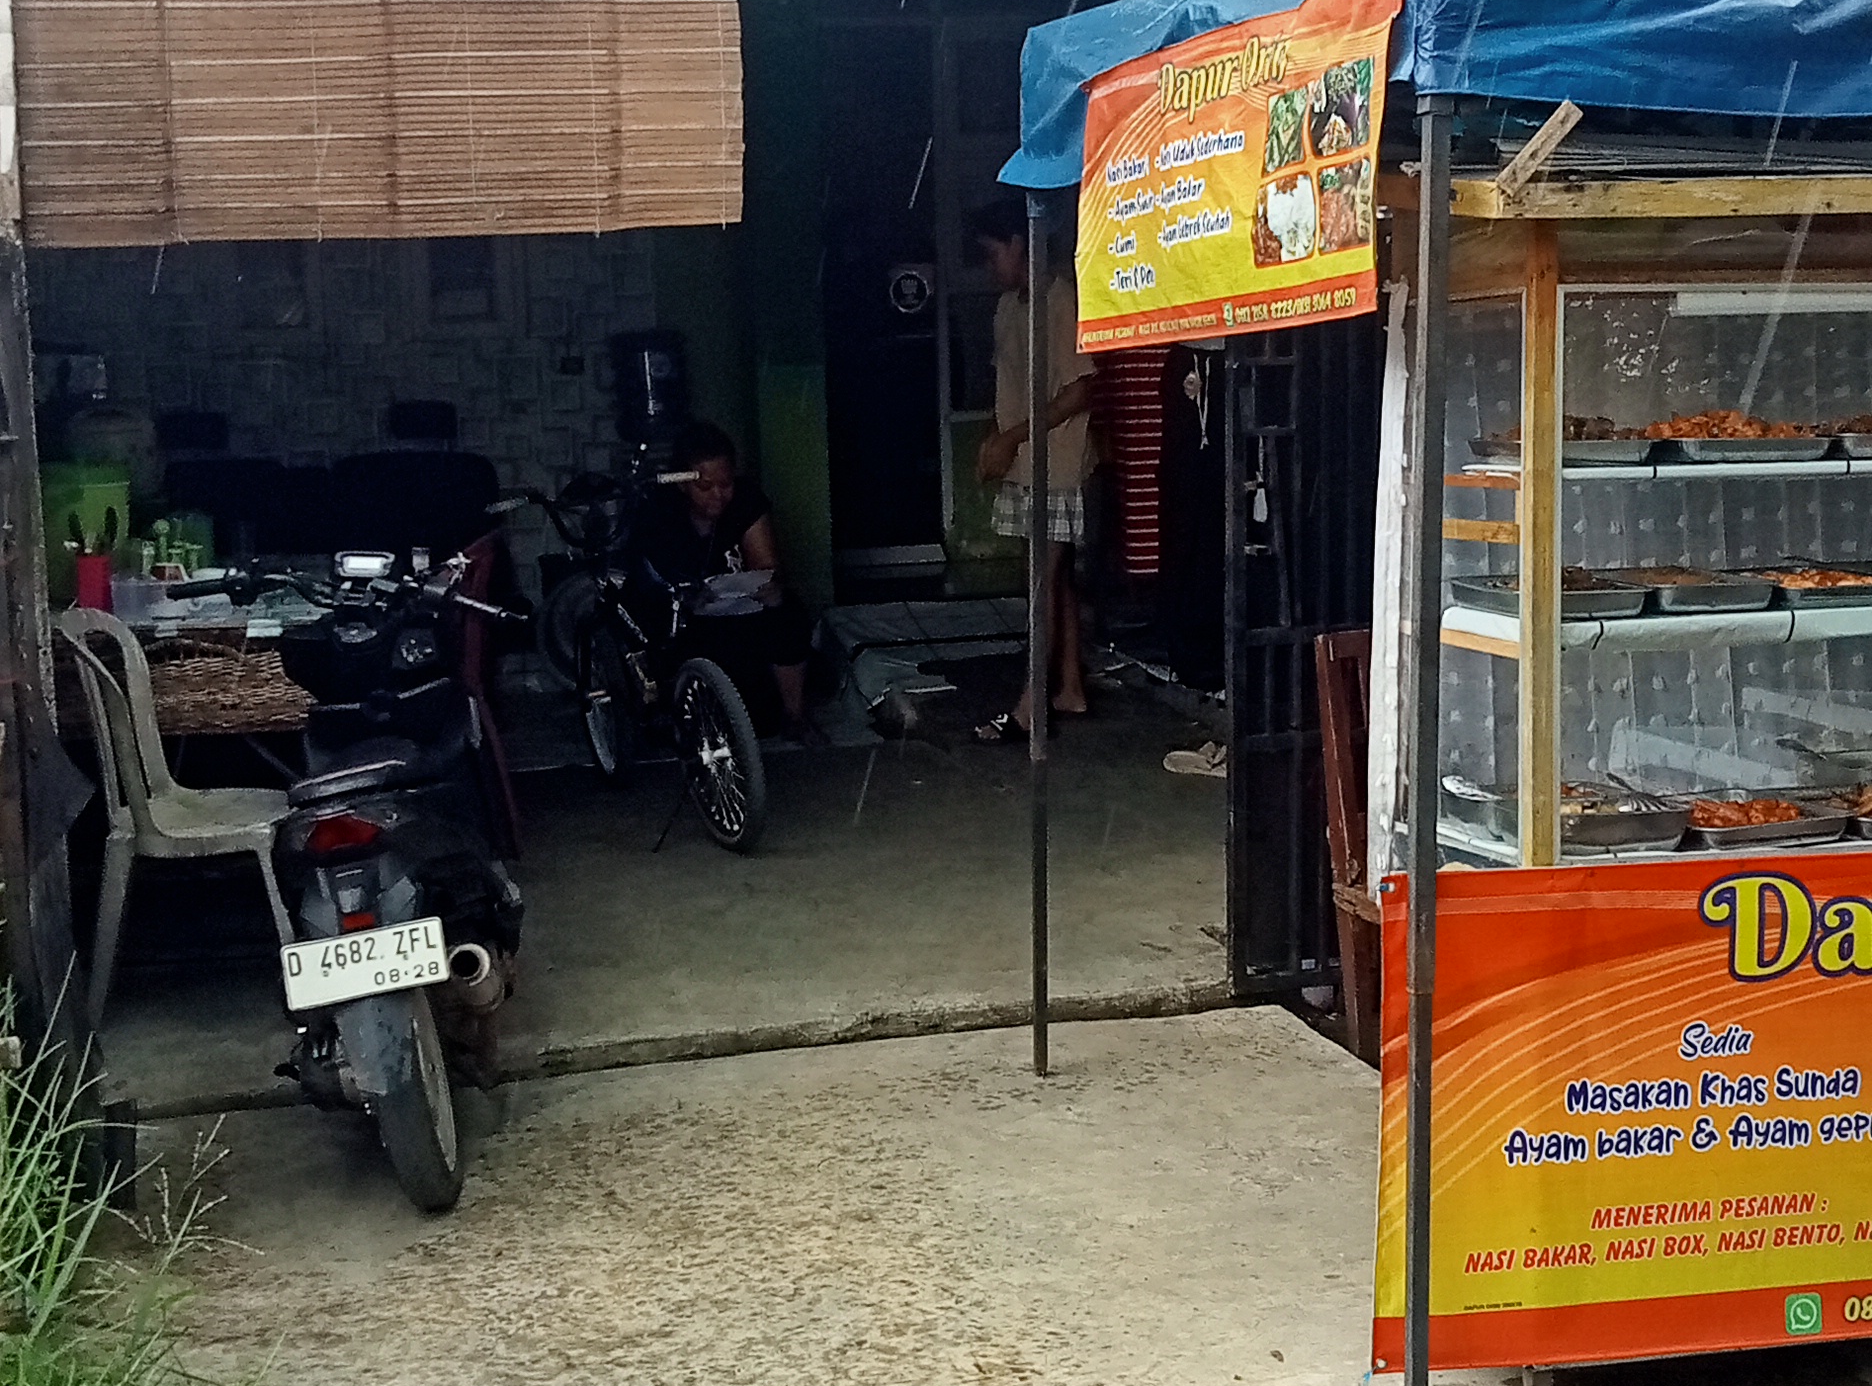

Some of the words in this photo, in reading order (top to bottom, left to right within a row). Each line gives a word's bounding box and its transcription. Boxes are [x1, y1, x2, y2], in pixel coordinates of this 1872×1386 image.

[1157, 61, 1240, 124] Dapur
[287, 951, 302, 977] D
[320, 936, 378, 970] 4682
[392, 925, 437, 957] ZFL
[1679, 1022, 1752, 1059] Sedia
[1566, 1080, 1690, 1112] Masakan
[1700, 1072, 1767, 1105] Khas
[1775, 1067, 1860, 1098] Sunda
[1503, 1129, 1588, 1164] Ayam
[1597, 1127, 1682, 1157] bakar
[1691, 1117, 1719, 1150] &
[1728, 1114, 1810, 1148] Ayam
[1819, 1113, 1872, 1142] gep
[1590, 1200, 1712, 1230] MENERIMA
[1719, 1193, 1816, 1220] PESANAN
[1464, 1249, 1516, 1274] NASI
[1522, 1242, 1598, 1269] BAKAR,
[1604, 1237, 1656, 1262] NASI
[1662, 1233, 1709, 1258] BOX,
[1716, 1228, 1767, 1253] NASI
[1772, 1223, 1846, 1247] BENTO,
